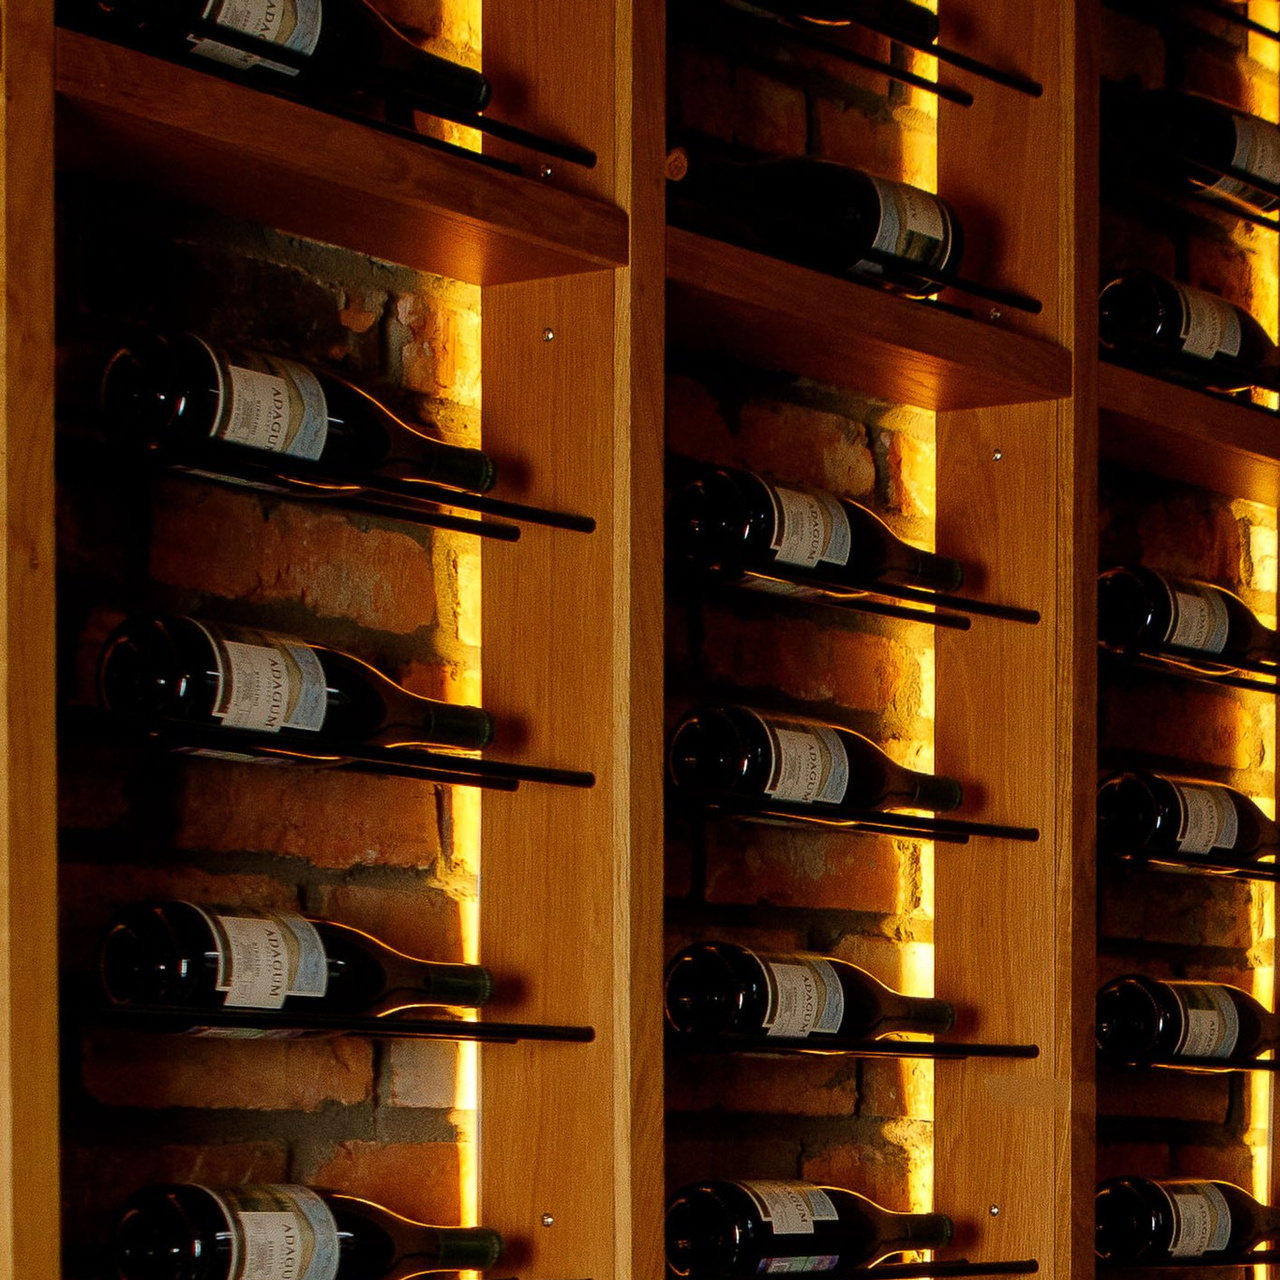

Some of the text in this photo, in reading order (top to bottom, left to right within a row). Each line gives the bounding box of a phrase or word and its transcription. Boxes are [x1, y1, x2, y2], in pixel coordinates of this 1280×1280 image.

[265, 658, 282, 727] ADAGUM
[802, 743, 817, 801] ADAGUM
[264, 928, 282, 997] ADAGUM
[800, 974, 813, 1033] ADAGUM
